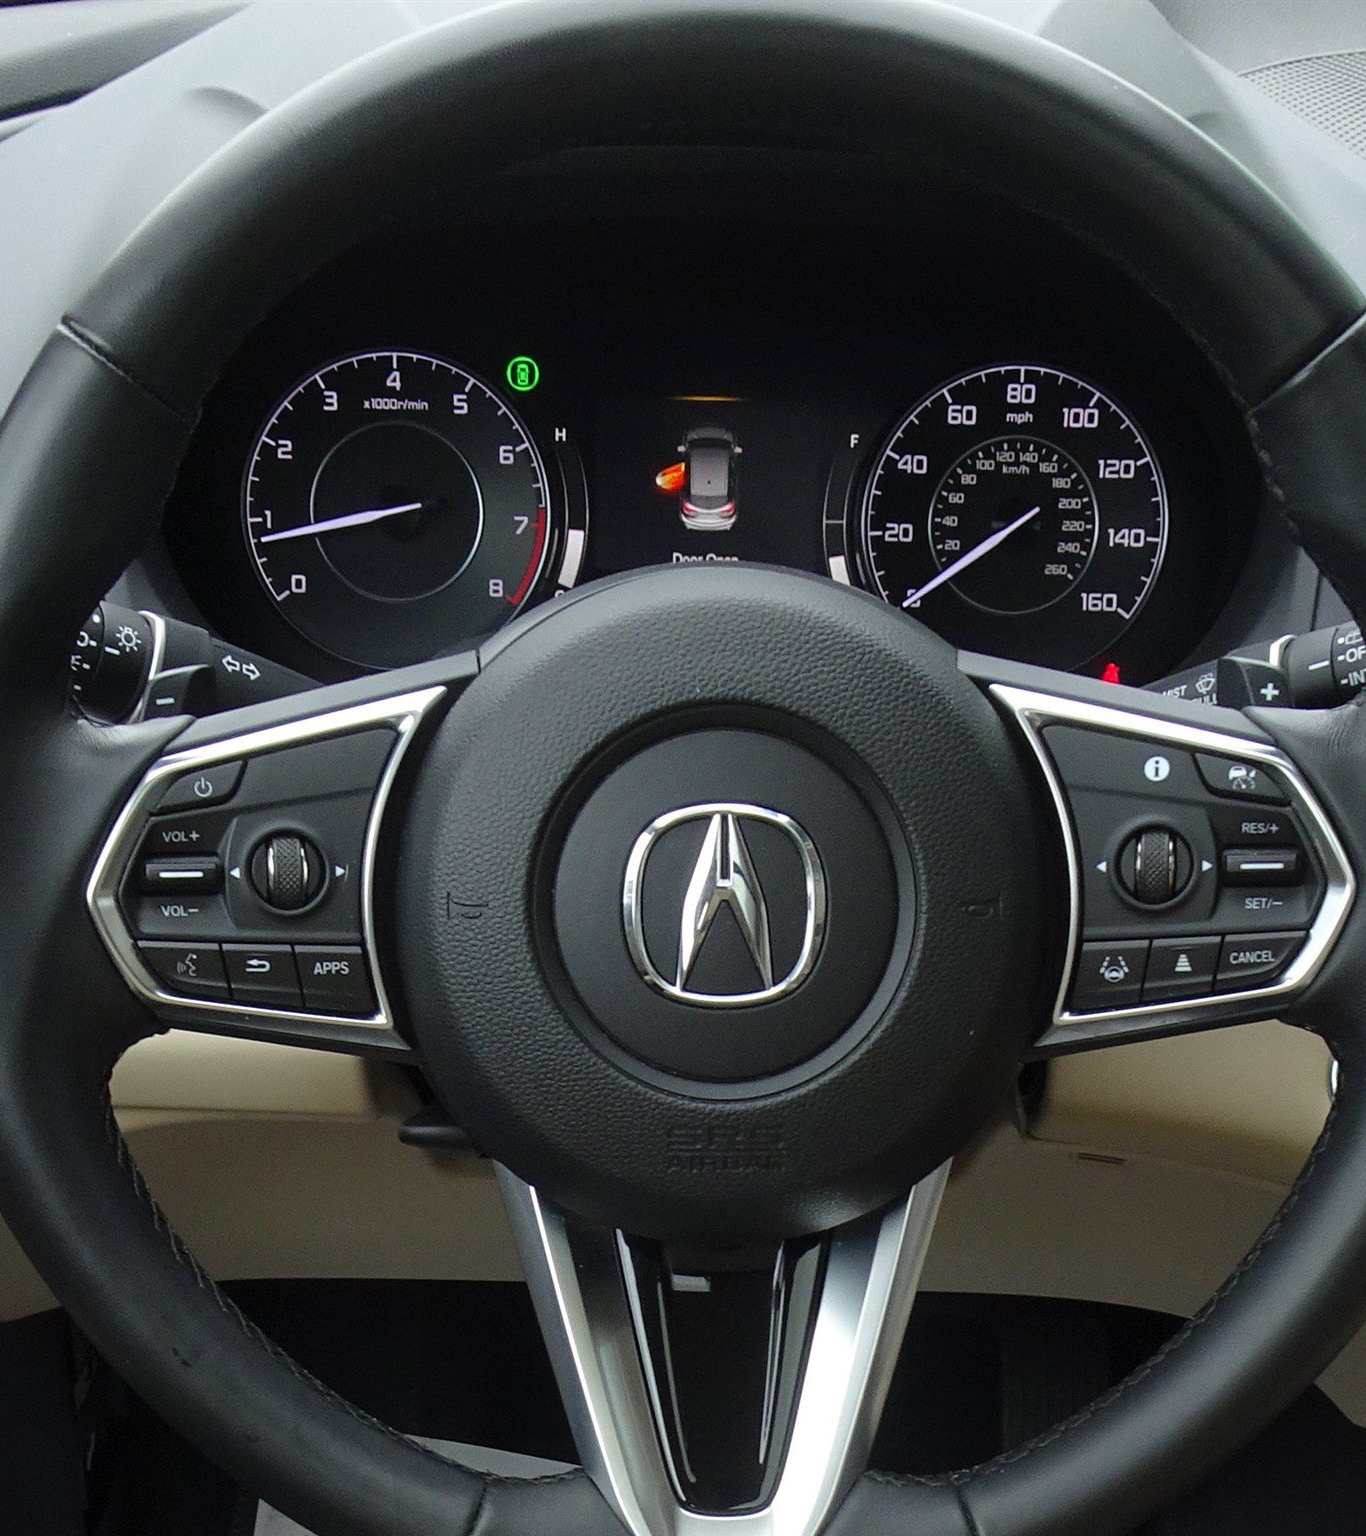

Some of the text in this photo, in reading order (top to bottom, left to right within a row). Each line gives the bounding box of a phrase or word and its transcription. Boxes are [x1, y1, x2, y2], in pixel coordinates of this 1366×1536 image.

[386, 371, 401, 390] 4
[324, 391, 338, 411] 3
[1007, 384, 1035, 404] 80
[363, 398, 428, 411] x1000r/min
[453, 394, 468, 414] 5
[947, 405, 977, 426] 60
[1006, 411, 1033, 424] mph
[1063, 407, 1099, 428] 100
[555, 427, 566, 441] H
[850, 434, 859, 448] F
[278, 440, 293, 459] 2
[499, 445, 514, 464] 6
[996, 451, 1015, 462] 120
[898, 454, 927, 474] 40
[1019, 452, 1038, 463] 140
[976, 460, 995, 470] 100
[1002, 464, 1030, 475] km/h
[1039, 462, 1058, 473] 160
[1099, 459, 1134, 479] 120
[961, 474, 977, 485] 80
[1051, 477, 1071, 489] 180
[948, 492, 964, 503] 60
[1058, 498, 1081, 509] 200
[265, 510, 272, 529] 1
[514, 516, 529, 534] 7
[942, 516, 958, 526] 40
[1061, 520, 1084, 531] 220
[884, 523, 913, 542] 20
[1108, 528, 1145, 547] 140
[944, 539, 960, 550] 20
[1057, 542, 1080, 553] 240
[1044, 564, 1067, 575] 260
[291, 574, 306, 593] 0
[489, 579, 503, 597] 8
[1081, 593, 1117, 611] 160
[1346, 645, 1366, 662] OF
[1229, 951, 1275, 965] CANCEL
[313, 961, 350, 975] APPS
